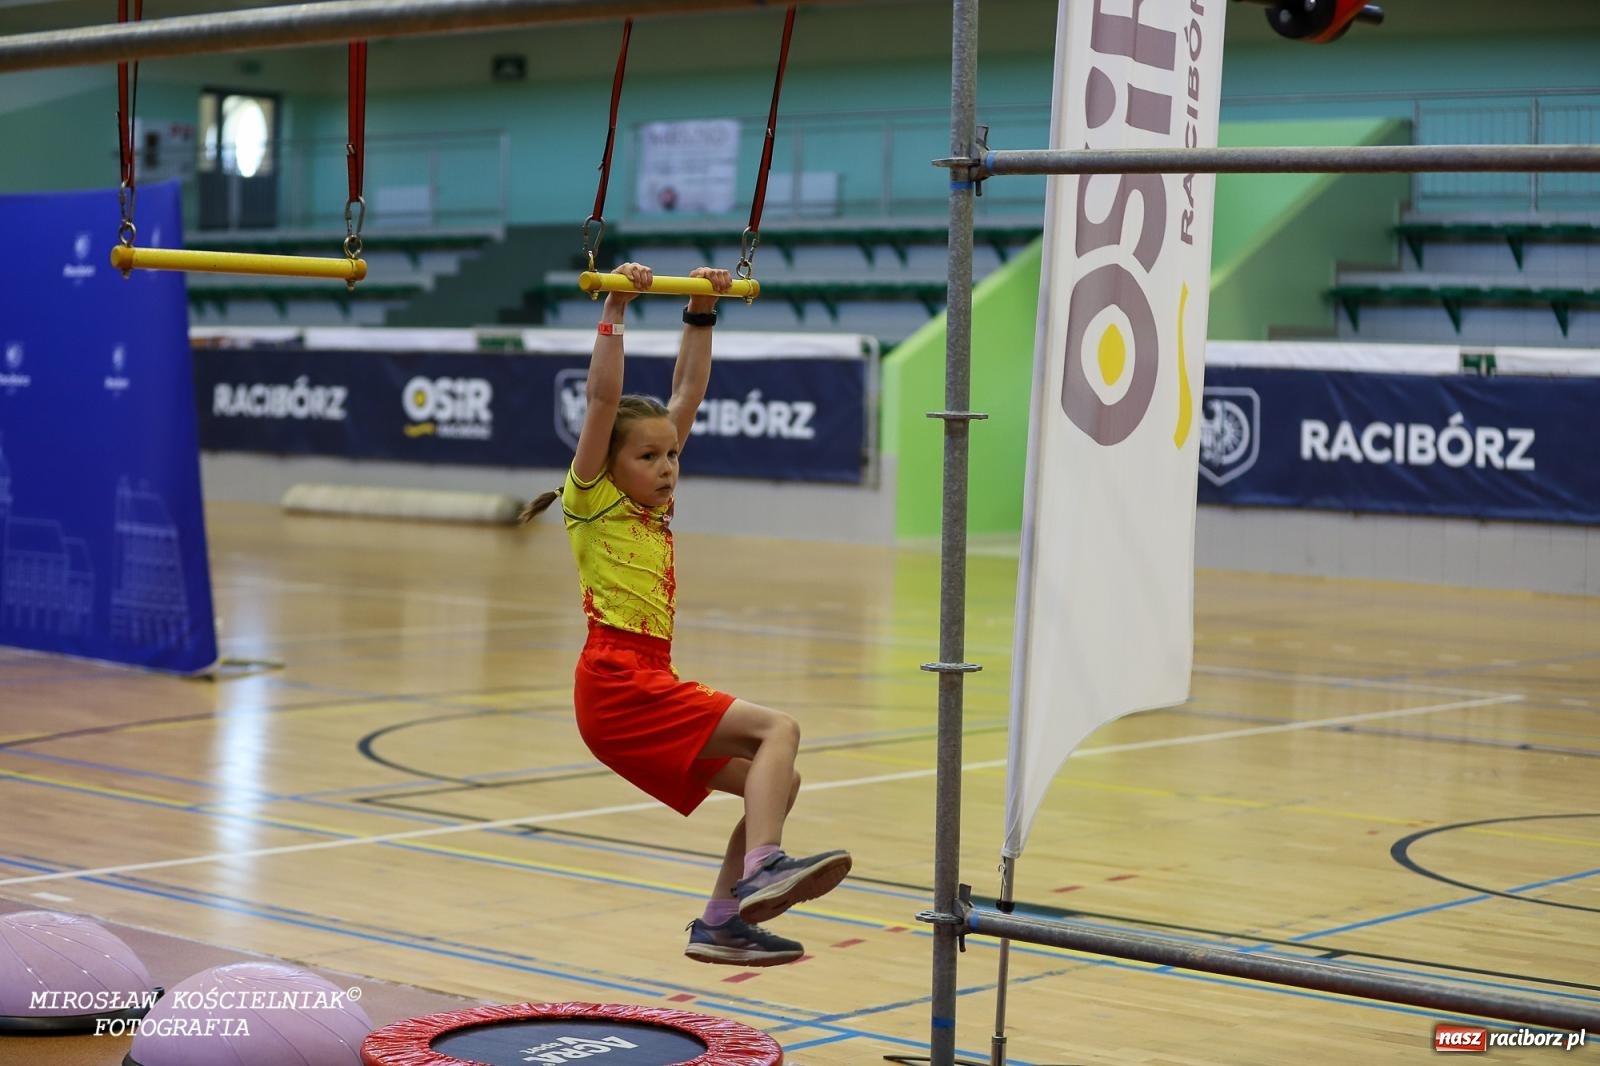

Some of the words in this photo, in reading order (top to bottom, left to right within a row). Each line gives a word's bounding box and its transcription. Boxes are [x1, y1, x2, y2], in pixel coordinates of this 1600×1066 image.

[212, 376, 348, 420] RACIBÓRZ
[691, 388, 816, 439] CIBÓRZ
[1300, 412, 1536, 471] RACIBÓRZ
